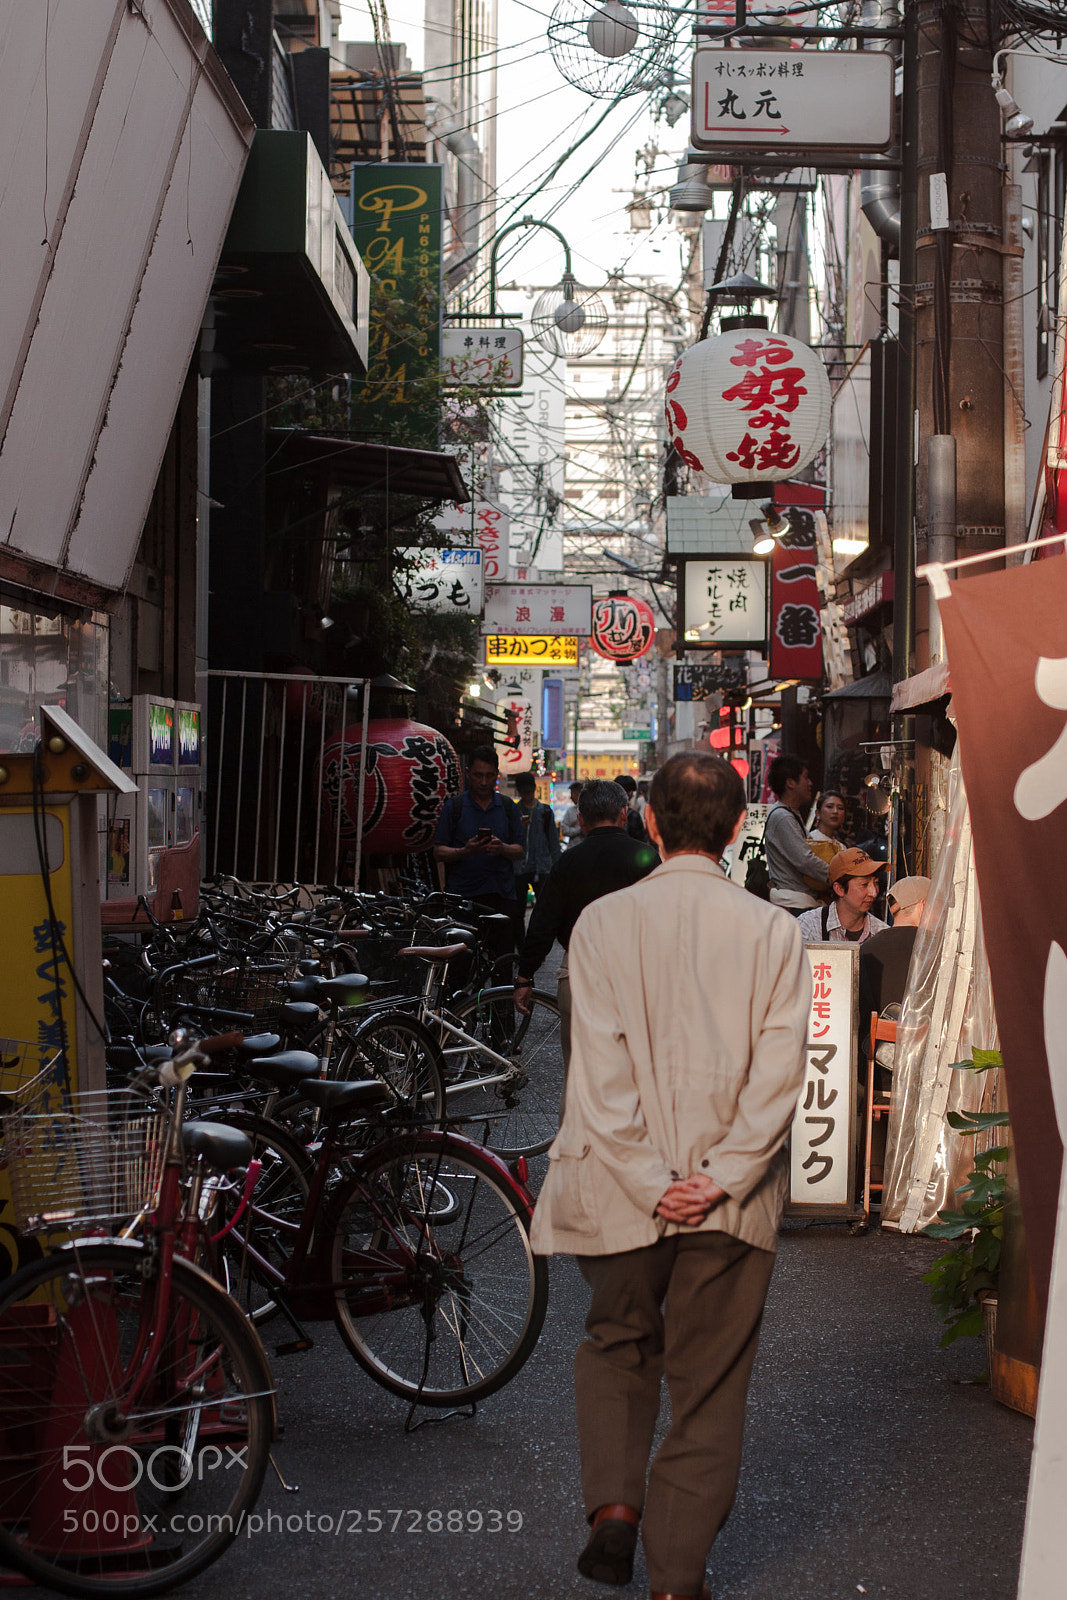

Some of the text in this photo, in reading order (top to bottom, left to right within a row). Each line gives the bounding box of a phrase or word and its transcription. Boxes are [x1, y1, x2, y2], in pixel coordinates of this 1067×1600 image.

[715, 61, 804, 78] すし・スッポン料理
[717, 88, 782, 119] 丸元
[464, 336, 506, 348] 串料理
[721, 338, 808, 470] お好み焼
[445, 551, 478, 564] Asahi
[707, 567, 724, 635] ホルモン
[727, 568, 749, 613] 焼肉
[515, 606, 566, 623] 浪漫
[489, 638, 548, 657] 串かつ
[813, 962, 832, 1039] ホルモン
[803, 1043, 838, 1185] マルフク
